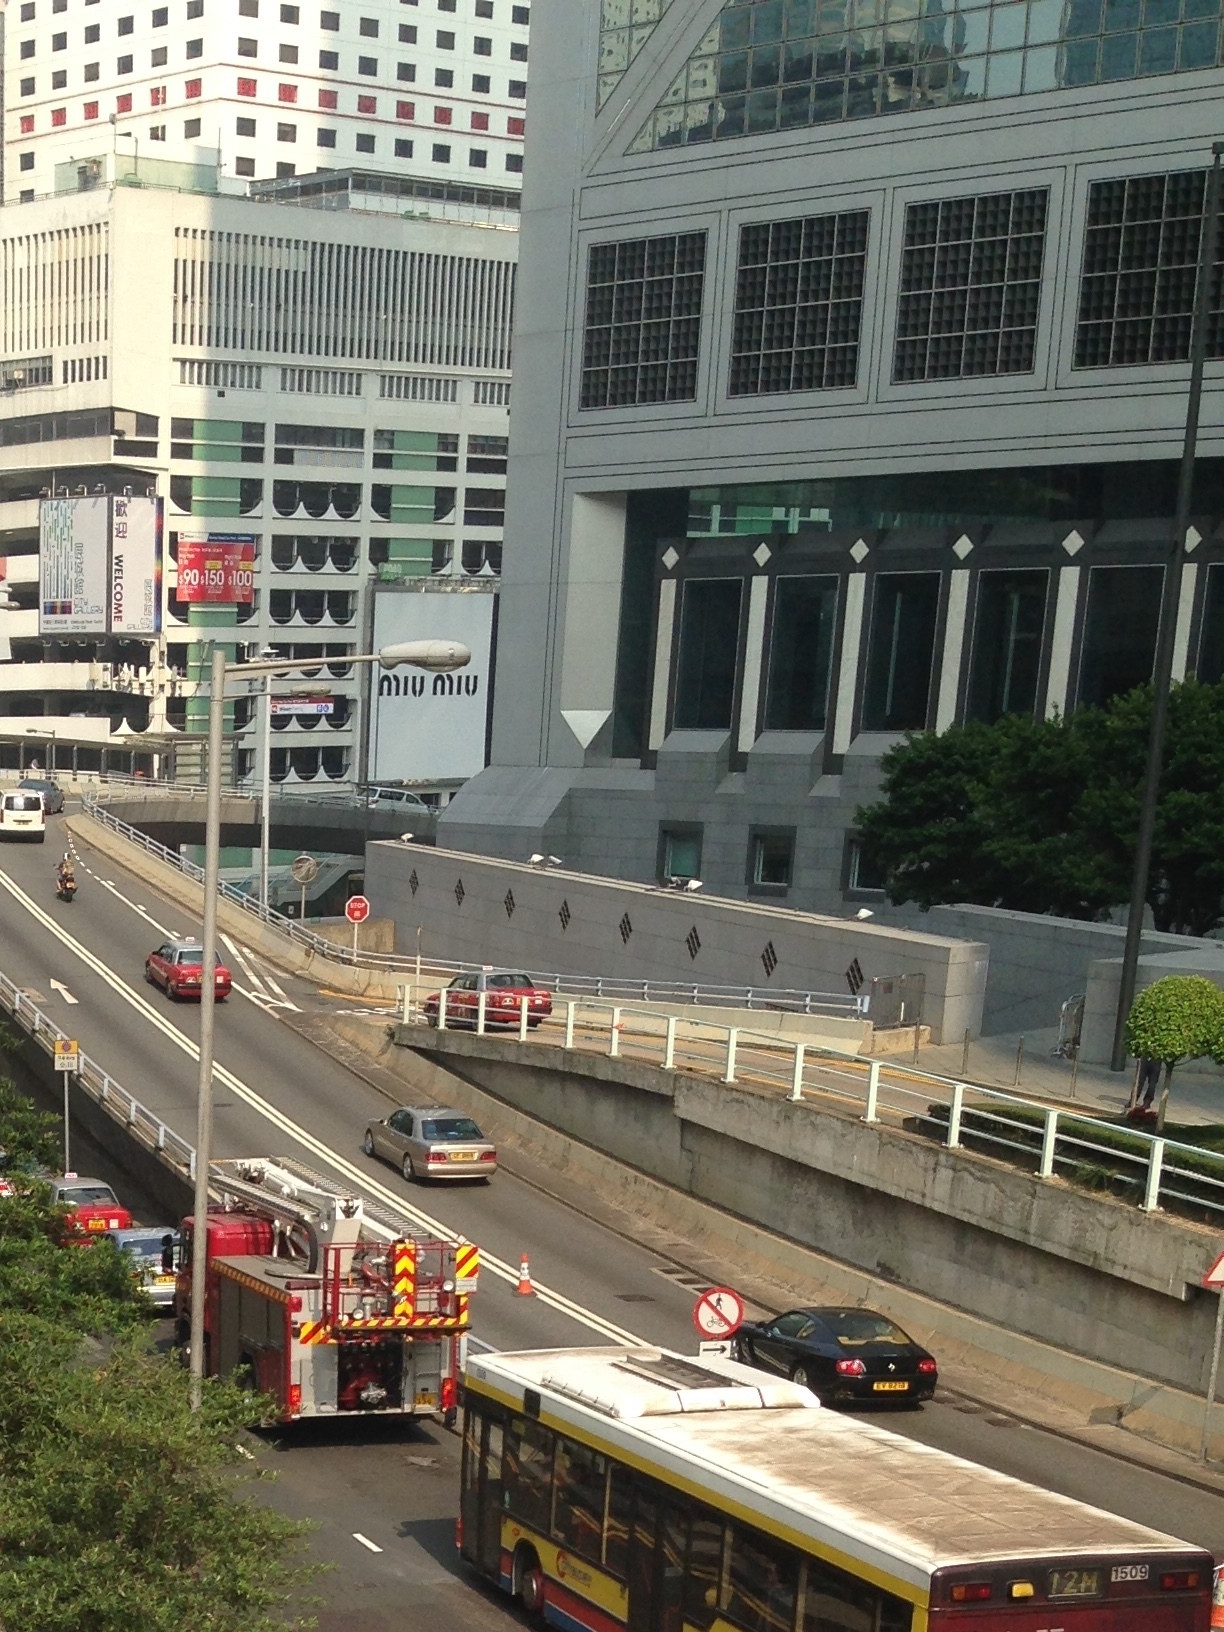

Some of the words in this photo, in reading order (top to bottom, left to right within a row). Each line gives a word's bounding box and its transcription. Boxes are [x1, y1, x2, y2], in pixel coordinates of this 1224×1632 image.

[178, 568, 199, 585] $90
[201, 570, 225, 586] $150
[228, 571, 252, 586] $100
[113, 554, 124, 622] WELCOME
[1112, 1565, 1149, 1581] 1509
